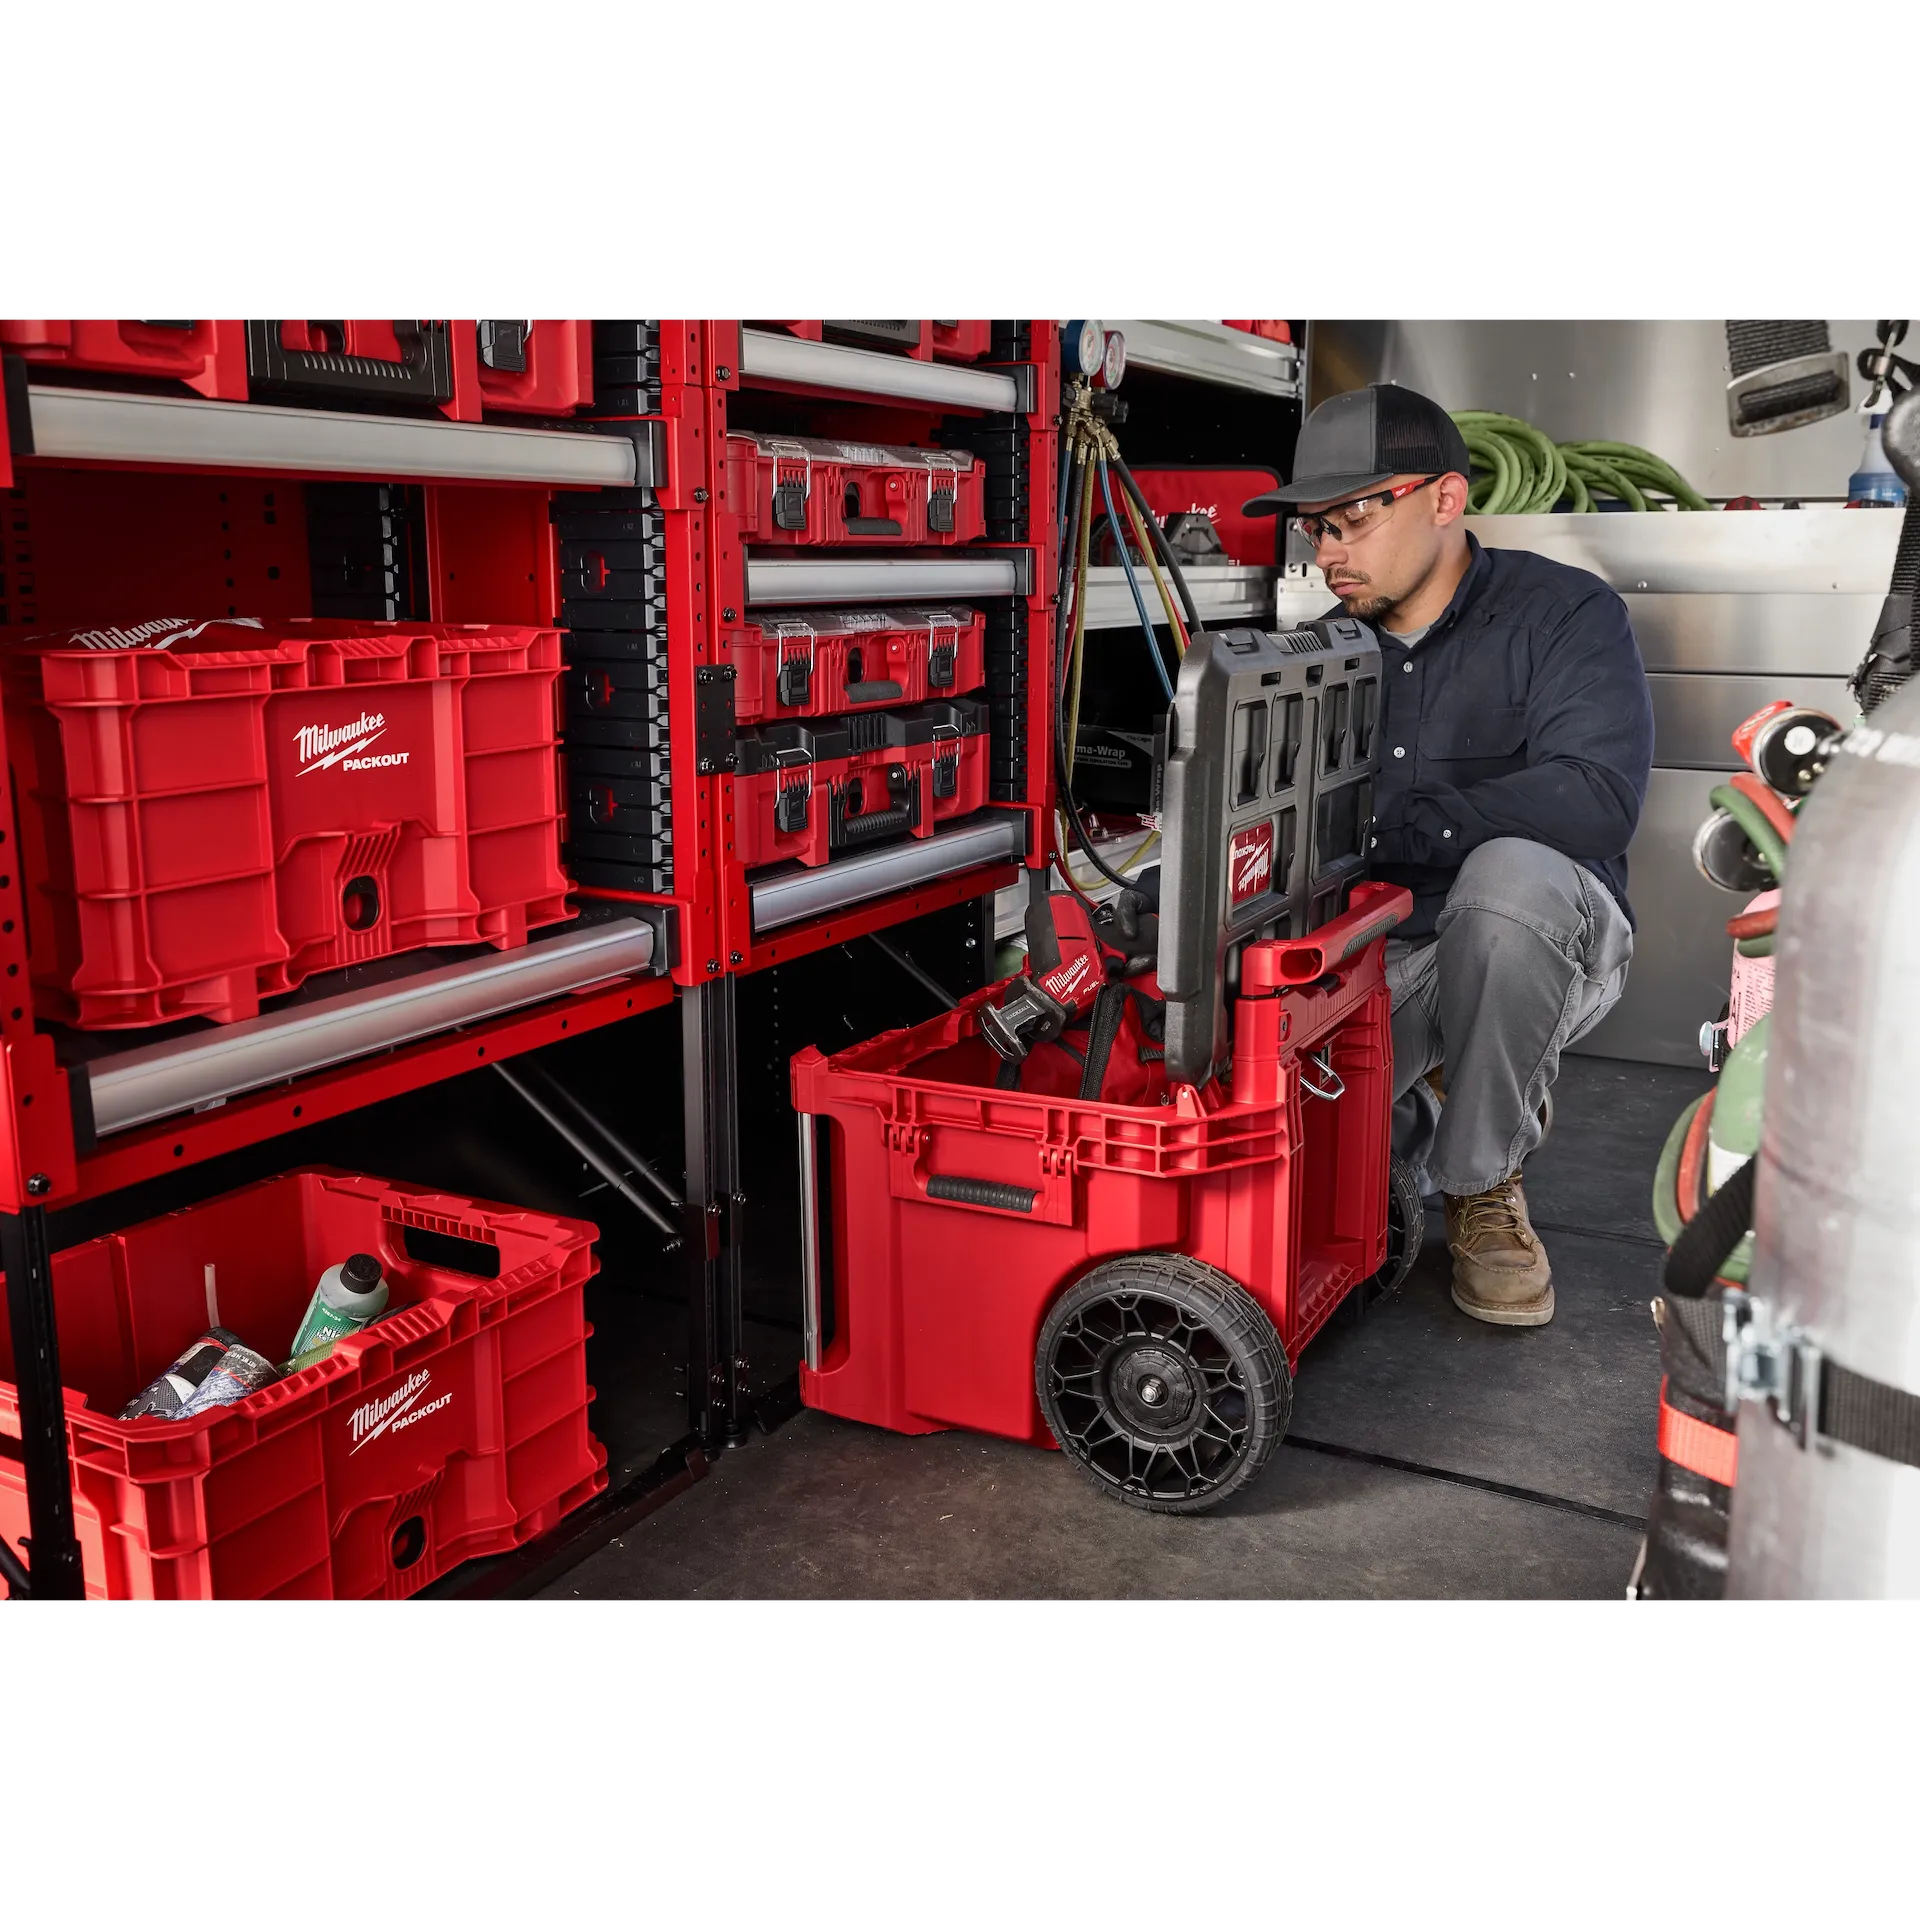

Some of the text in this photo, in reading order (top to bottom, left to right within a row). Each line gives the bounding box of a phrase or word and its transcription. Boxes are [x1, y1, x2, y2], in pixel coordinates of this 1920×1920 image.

[293, 712, 386, 763] Milwaukee
[343, 752, 410, 772] PACKOUT
[1238, 847, 1270, 893] Milwaukee
[1045, 954, 1089, 996] Milwaukee
[1083, 980, 1100, 995] FUEL
[347, 1369, 431, 1442] Milwaukee
[391, 1393, 453, 1433] PACKOUT
